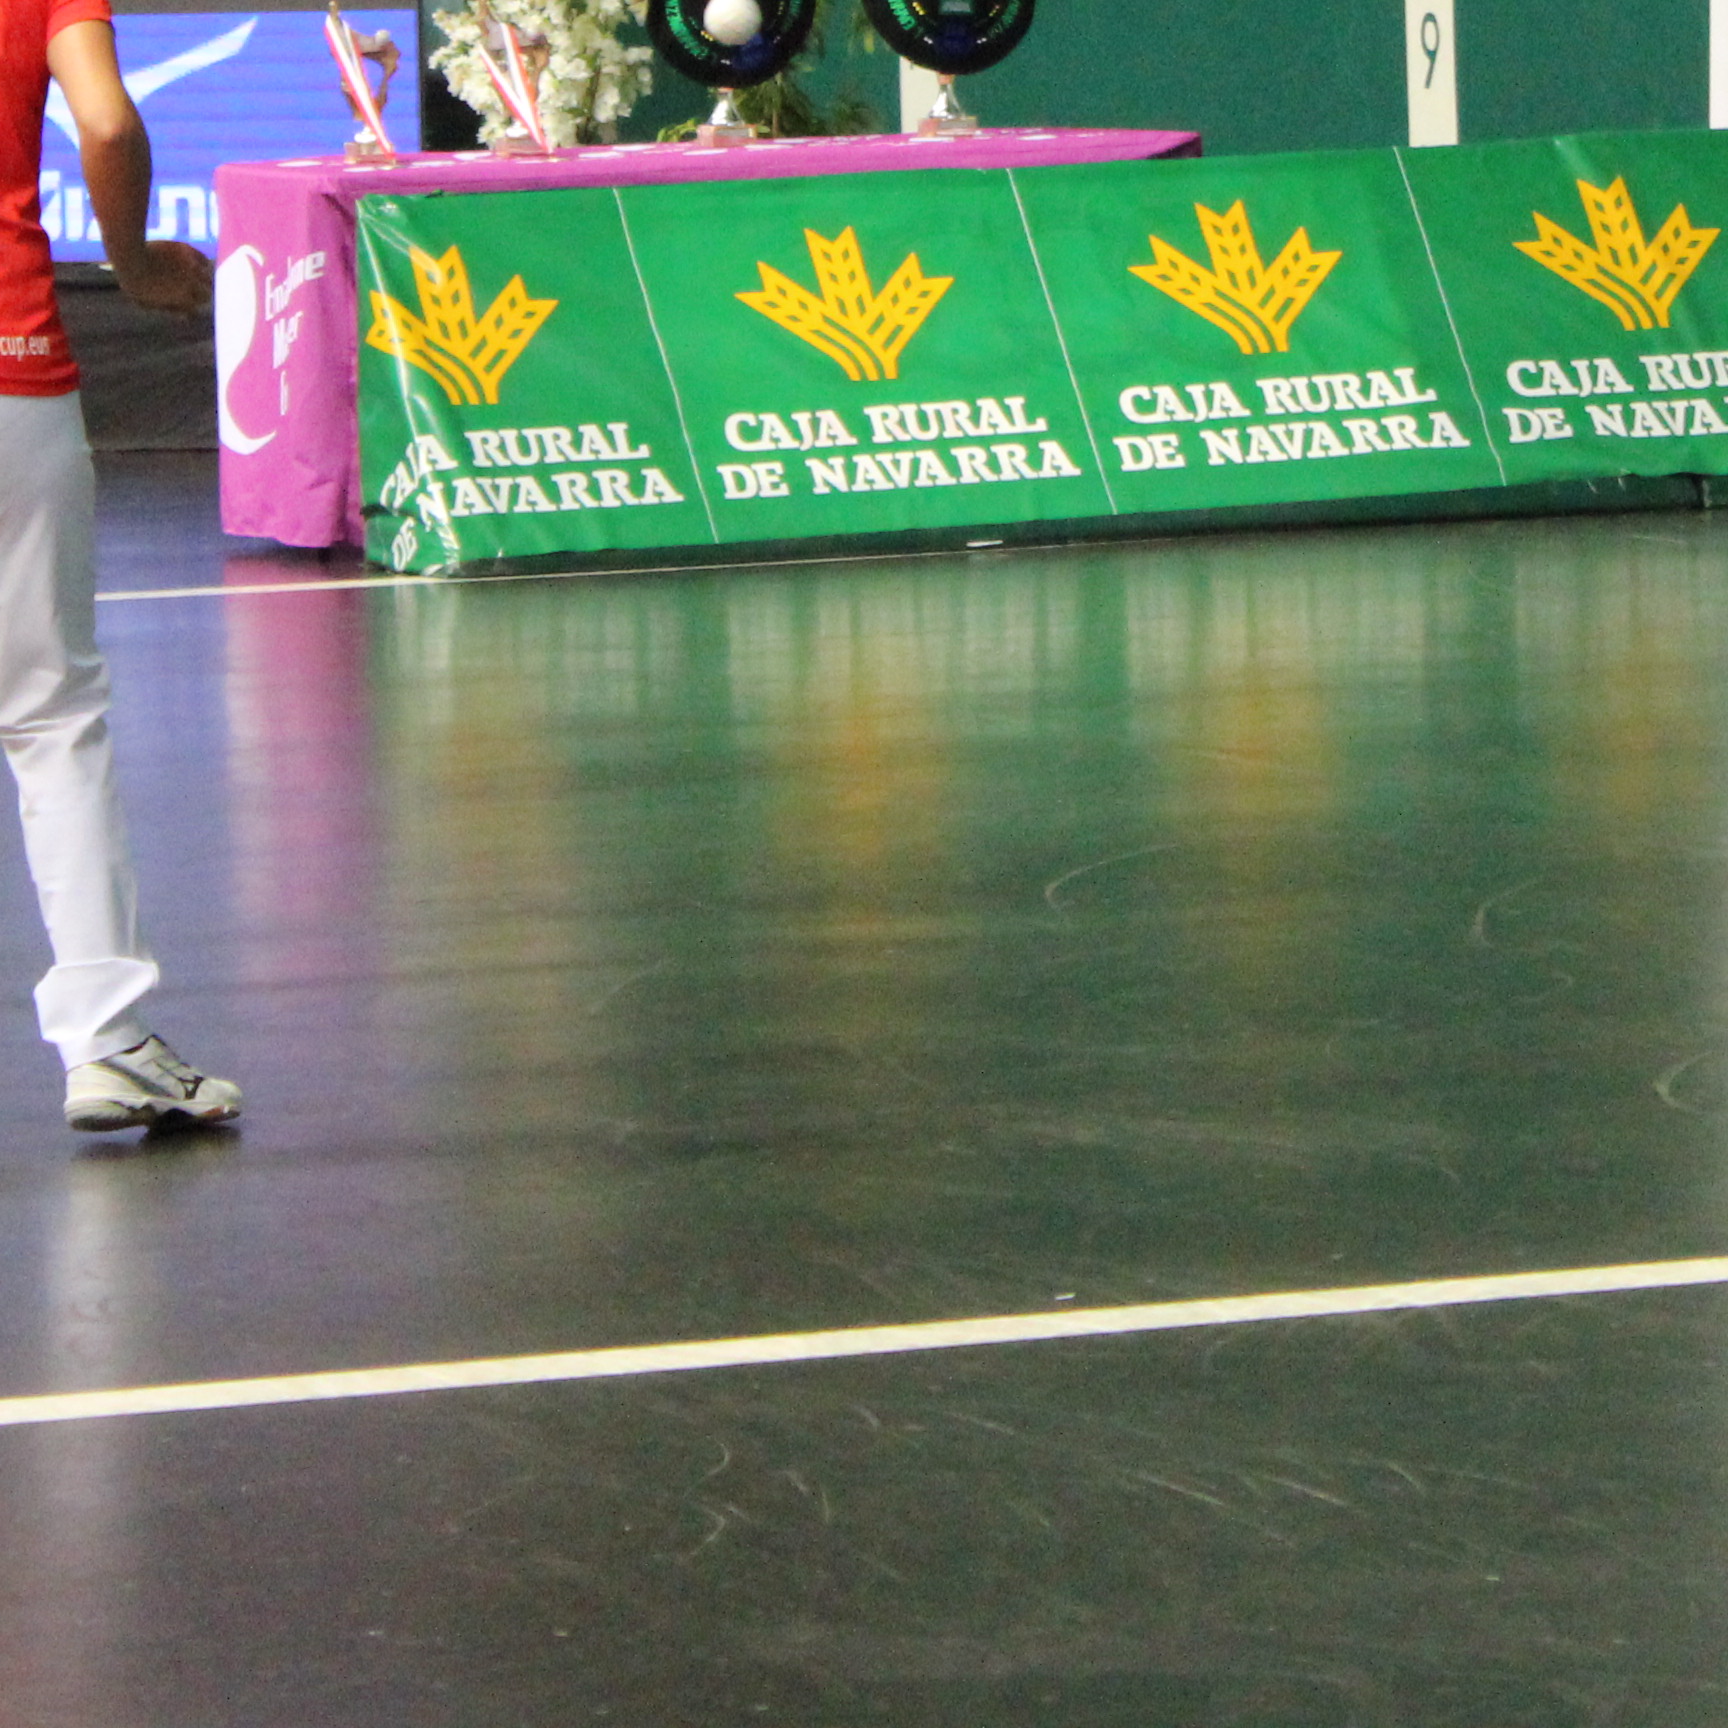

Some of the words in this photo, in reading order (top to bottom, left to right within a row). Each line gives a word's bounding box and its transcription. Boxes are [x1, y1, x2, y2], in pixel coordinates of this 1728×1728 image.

[1421, 12, 1439, 89] 9
[1119, 382, 1251, 423] CAJA
[1256, 367, 1437, 414] RURAL
[1507, 358, 1634, 396] CAJA
[465, 423, 650, 467] RURAL
[725, 410, 858, 452] CAJA
[865, 396, 1048, 443] RURAL
[1113, 433, 1186, 471] DE
[1205, 412, 1470, 465] NAVARRA
[1502, 408, 1573, 442] DE
[717, 461, 789, 499] DE
[807, 440, 1081, 494] NAVARRA
[392, 517, 418, 571] DE
